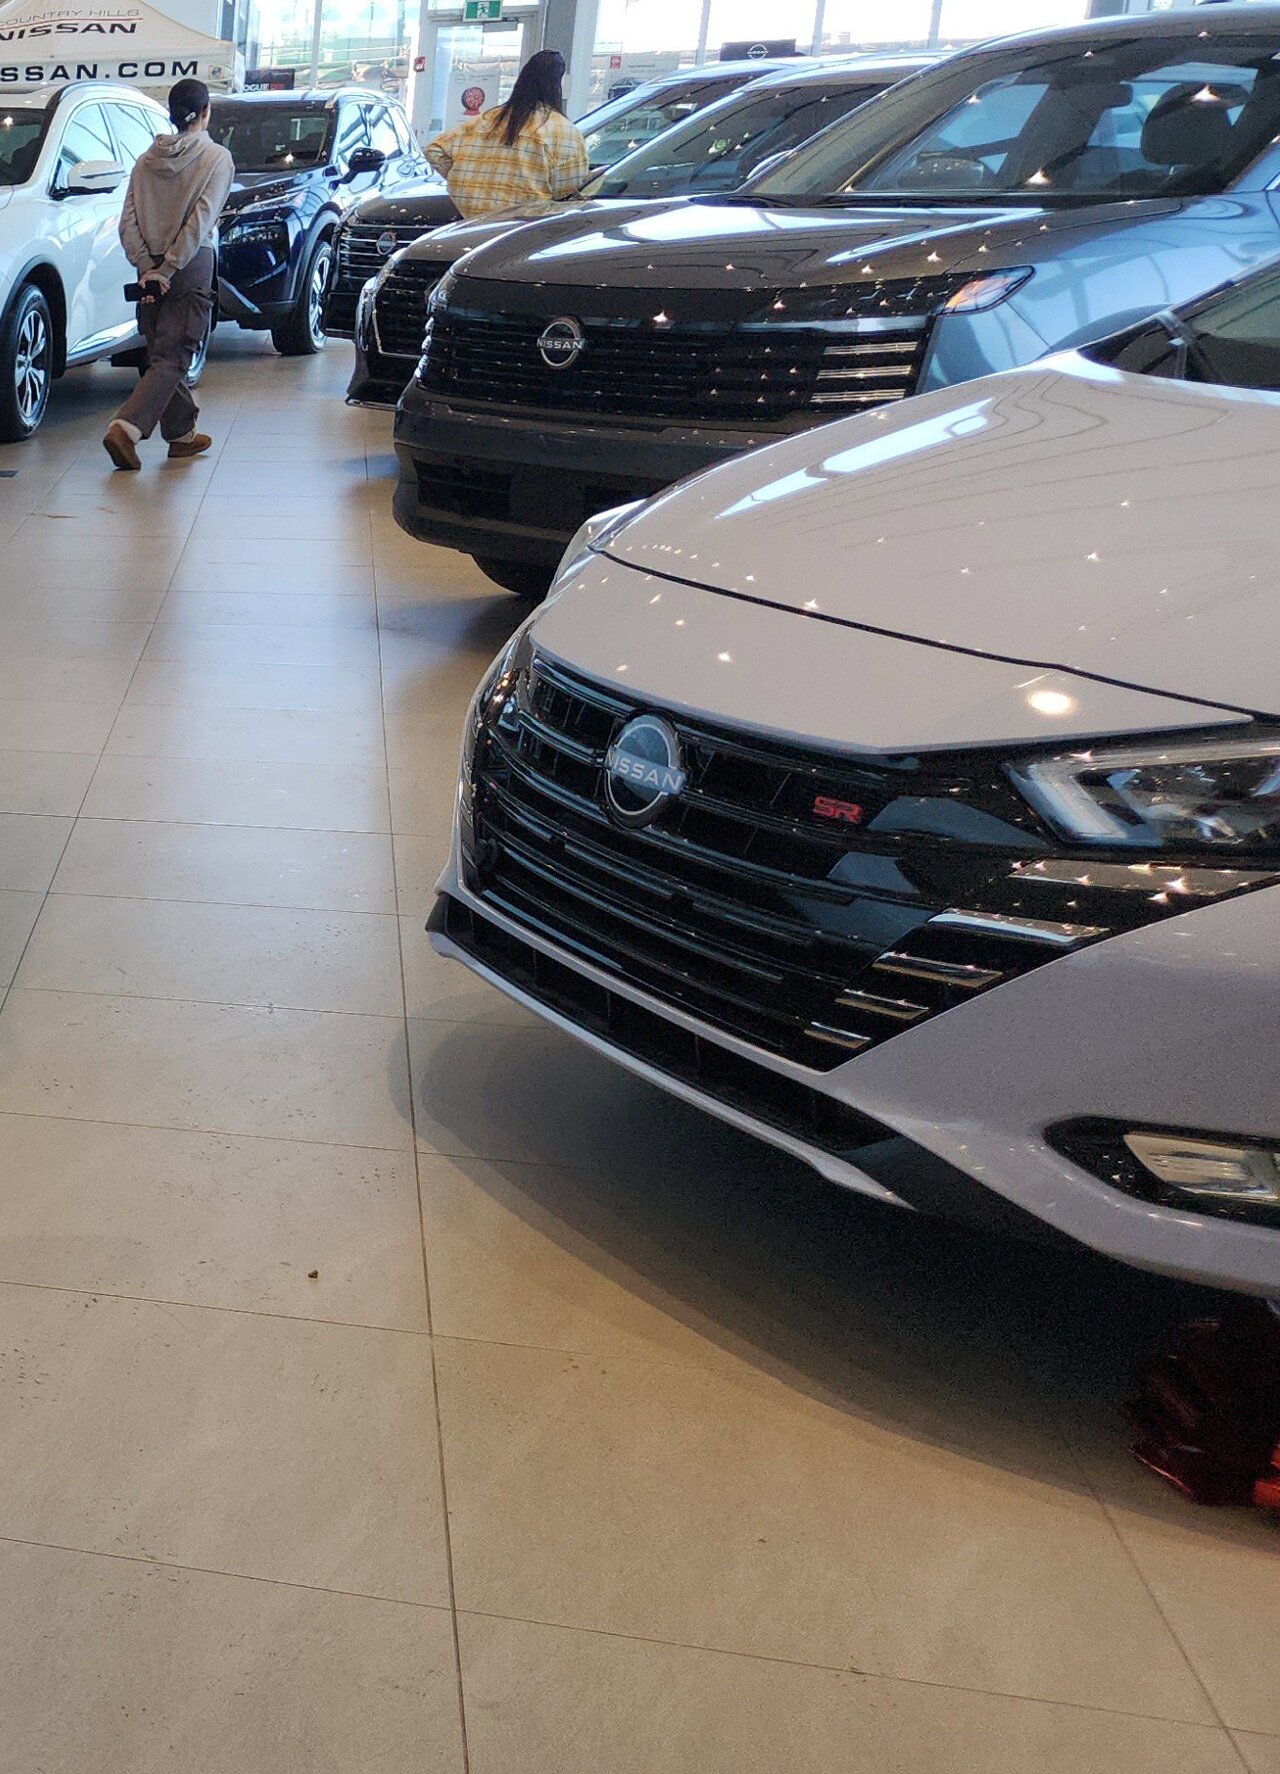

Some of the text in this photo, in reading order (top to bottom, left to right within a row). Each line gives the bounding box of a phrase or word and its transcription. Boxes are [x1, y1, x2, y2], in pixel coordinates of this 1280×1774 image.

[90, 9, 140, 17] HILLS
[536, 338, 583, 349] NISSAN
[605, 748, 684, 791] NISSAN
[813, 796, 862, 824] SR
